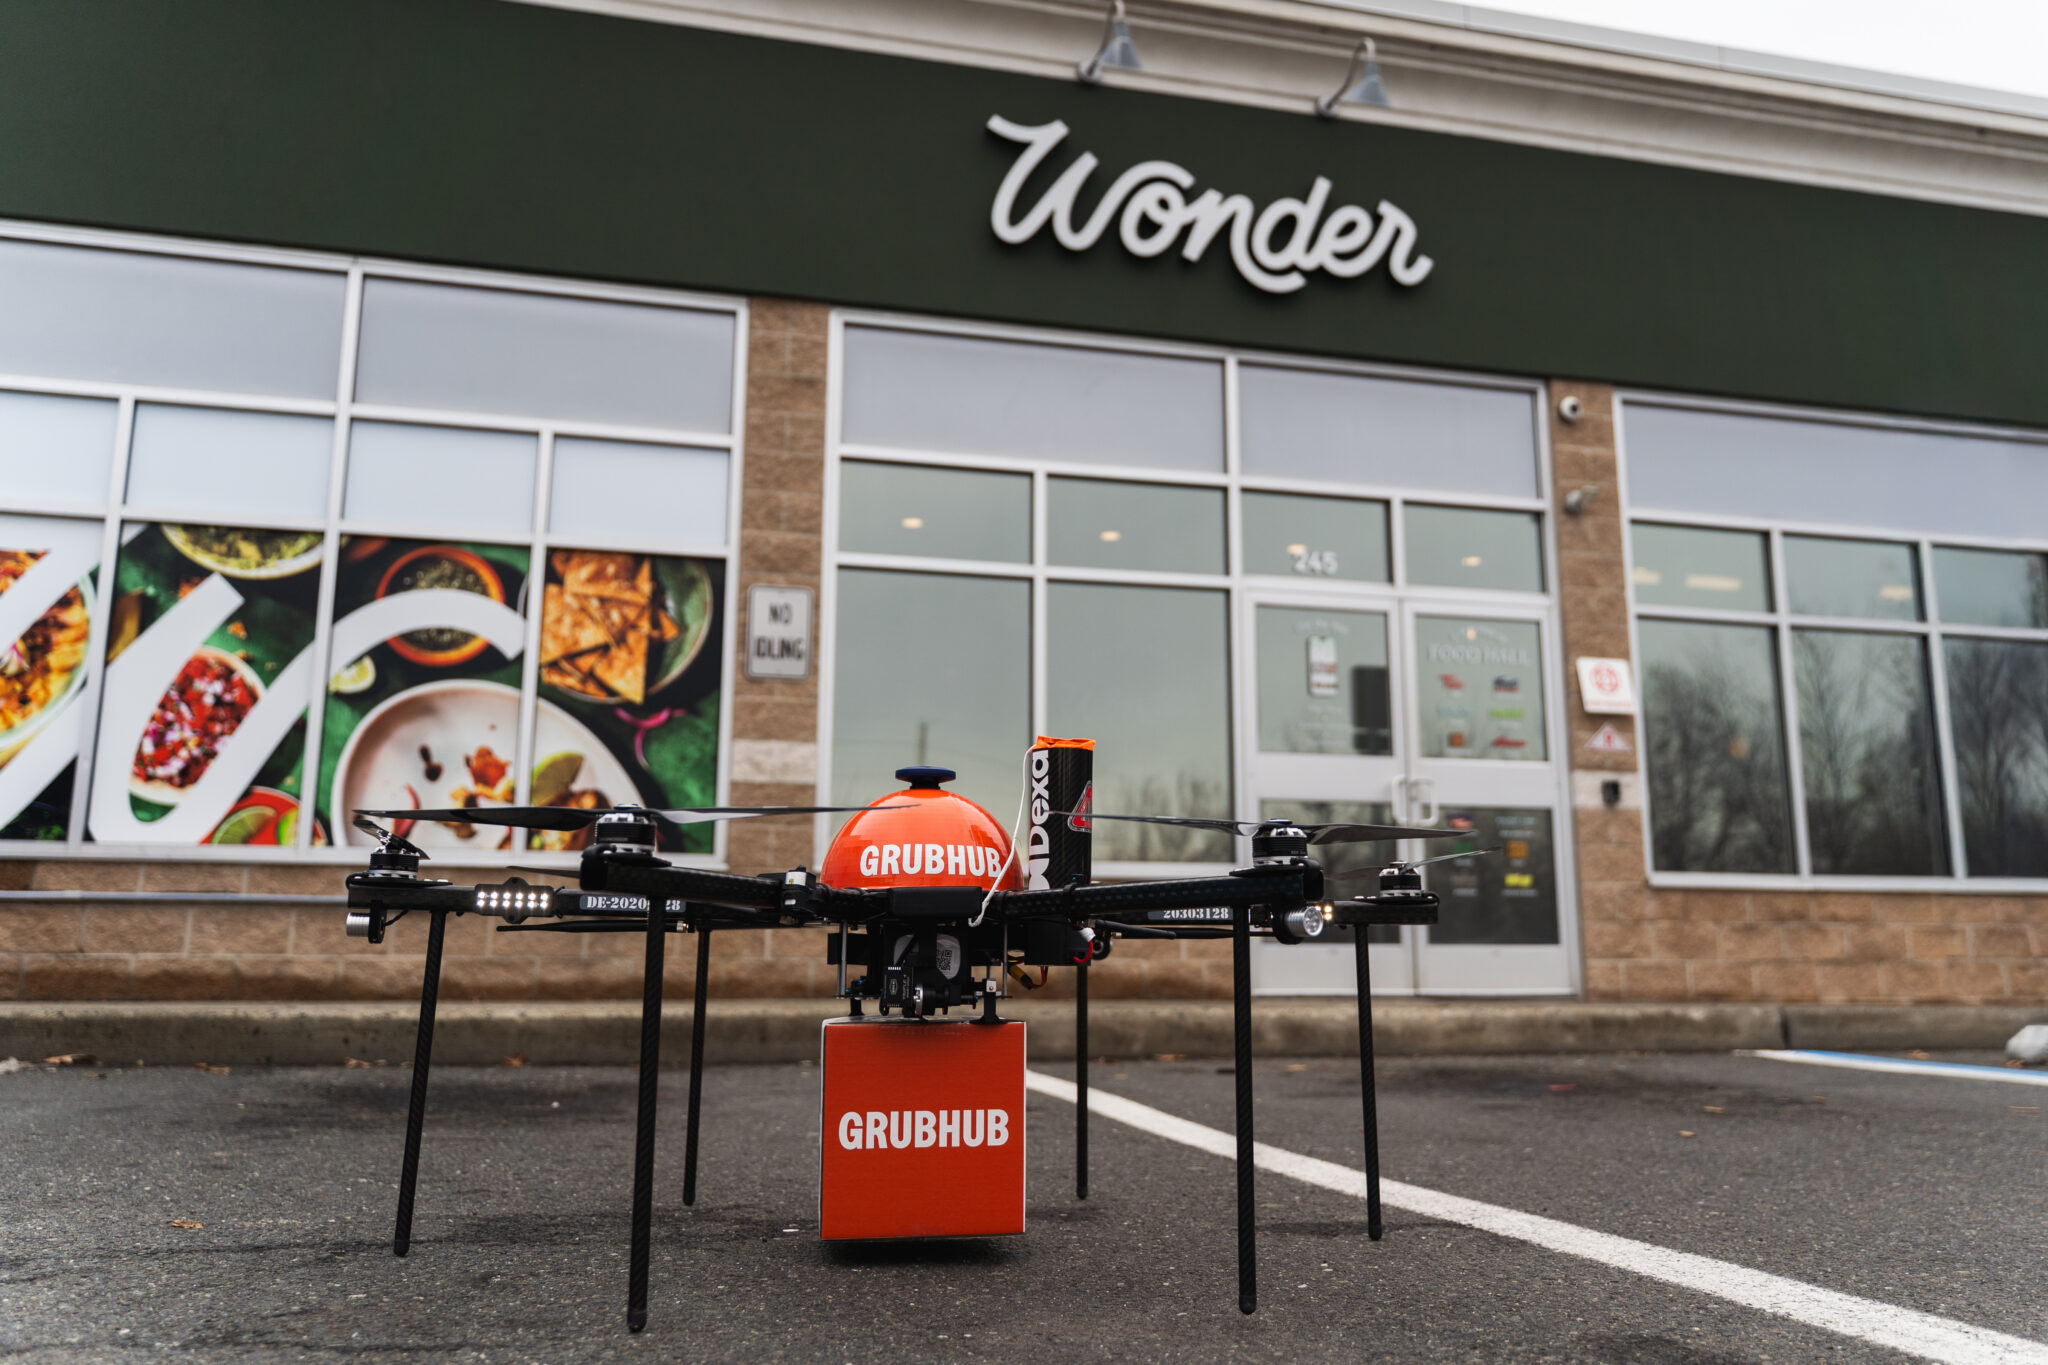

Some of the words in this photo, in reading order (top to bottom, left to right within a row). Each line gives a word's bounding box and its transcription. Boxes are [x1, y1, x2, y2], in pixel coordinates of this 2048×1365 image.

[986, 114, 1434, 293] Wonder
[1294, 550, 1338, 575] 245
[769, 603, 792, 624] NO
[1030, 750, 1050, 854] Dexa
[860, 844, 1001, 878] GRUBHUB
[587, 896, 680, 911] DE-202028
[838, 1109, 1009, 1150] GRUBHUB
